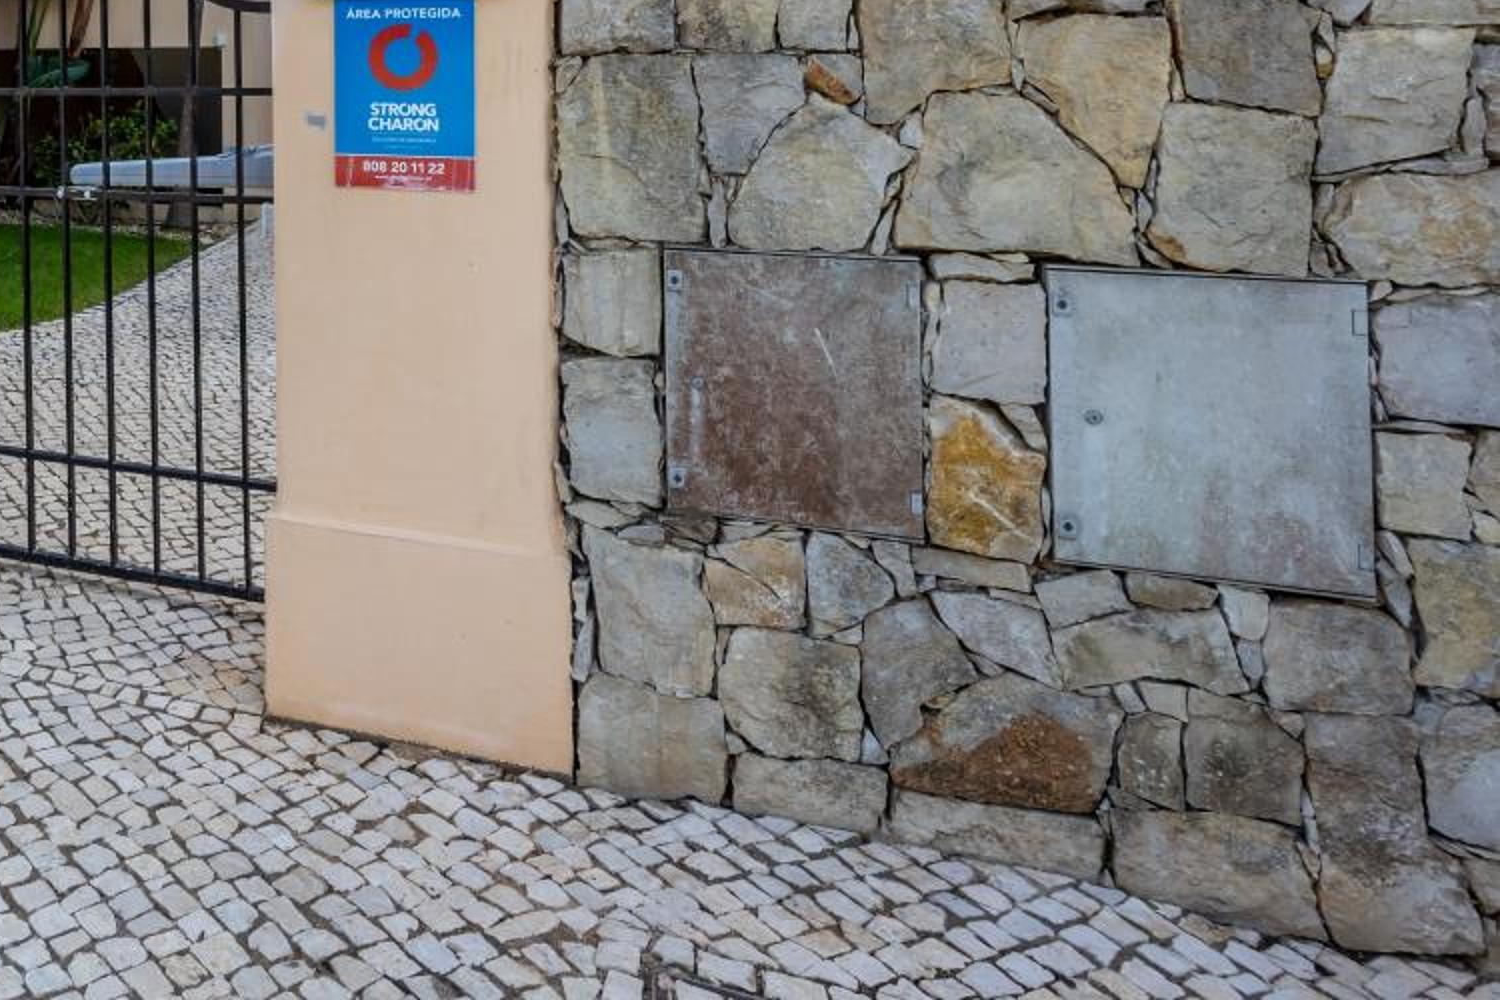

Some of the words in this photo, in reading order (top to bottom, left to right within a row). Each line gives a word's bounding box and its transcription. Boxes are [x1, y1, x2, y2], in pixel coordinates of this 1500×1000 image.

[346, 6, 381, 19] ÁREA
[385, 7, 461, 19] PROTEGIDA
[370, 102, 437, 117] STRONG
[367, 117, 440, 132] CHARON
[391, 161, 407, 173] 20
[411, 161, 425, 173] 11
[428, 163, 445, 174] 22
